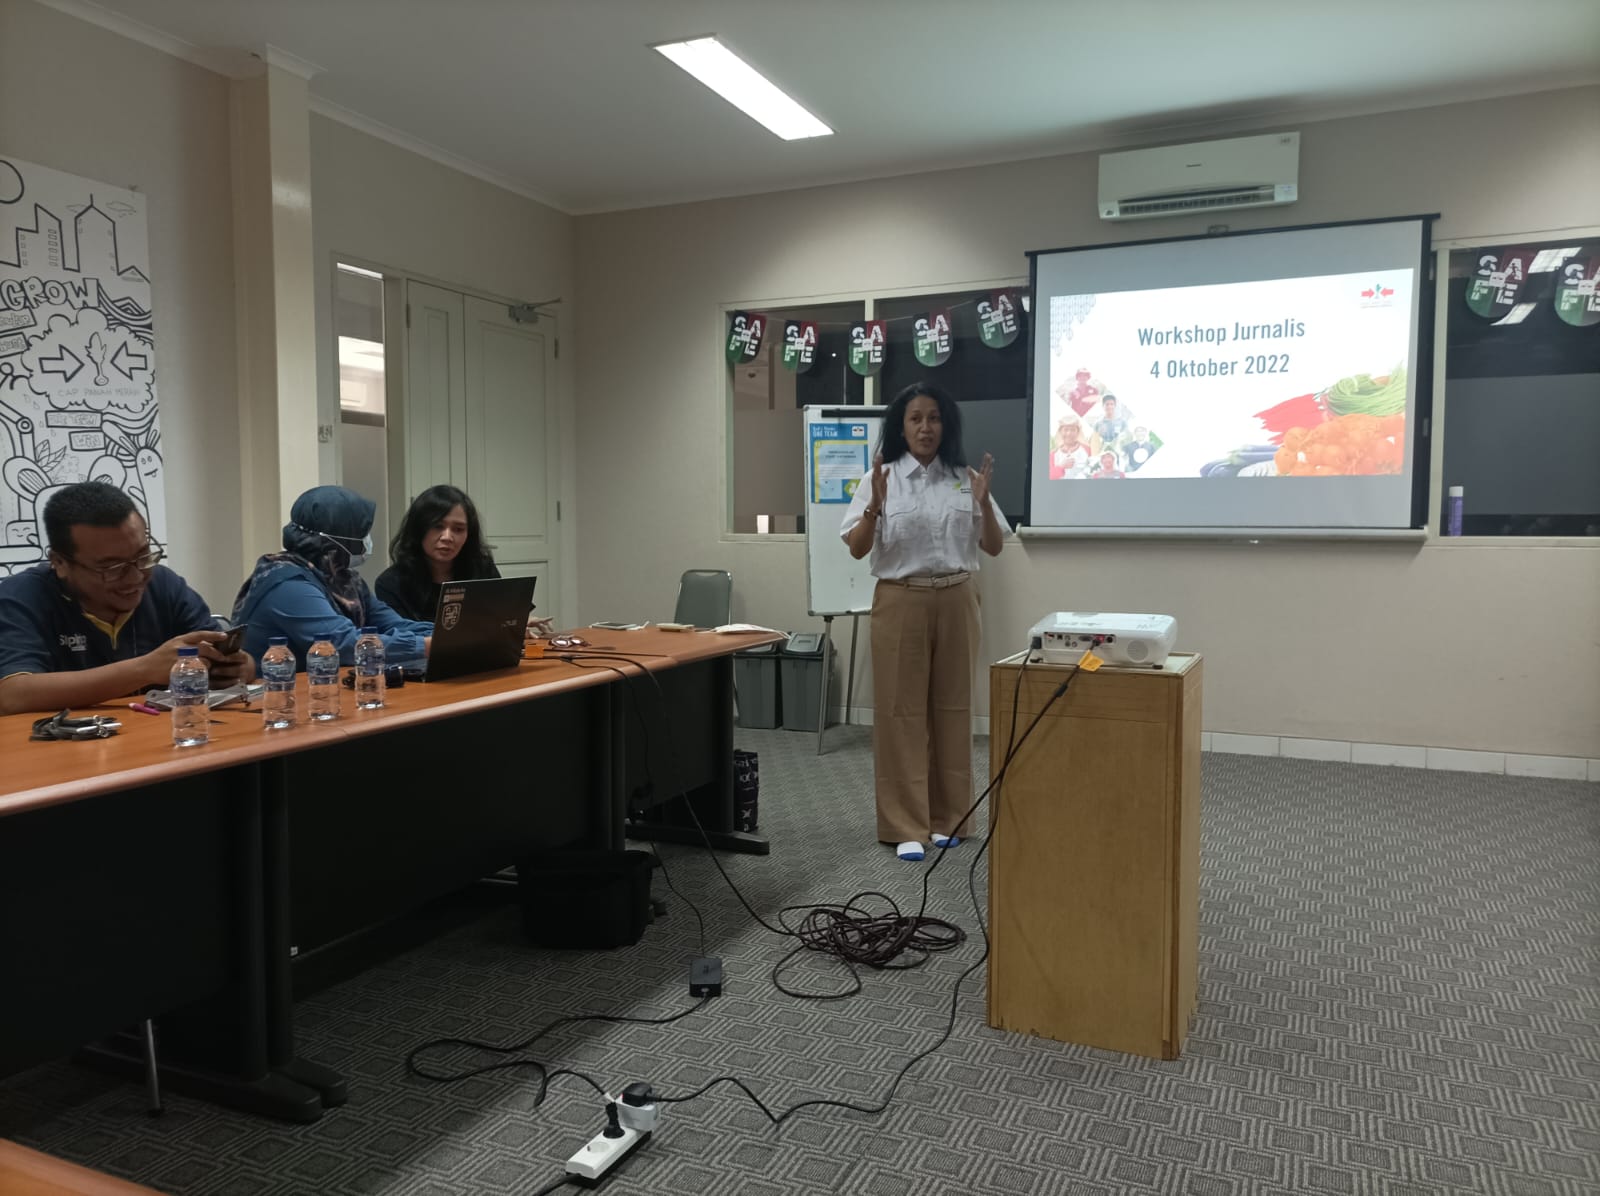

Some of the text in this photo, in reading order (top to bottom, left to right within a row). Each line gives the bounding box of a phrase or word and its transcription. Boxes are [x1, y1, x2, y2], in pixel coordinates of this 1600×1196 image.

[0, 276, 100, 311] GROW
[1137, 318, 1305, 347] Workshop Jurnalis
[1150, 354, 1290, 378] 4 Oktober 2022
